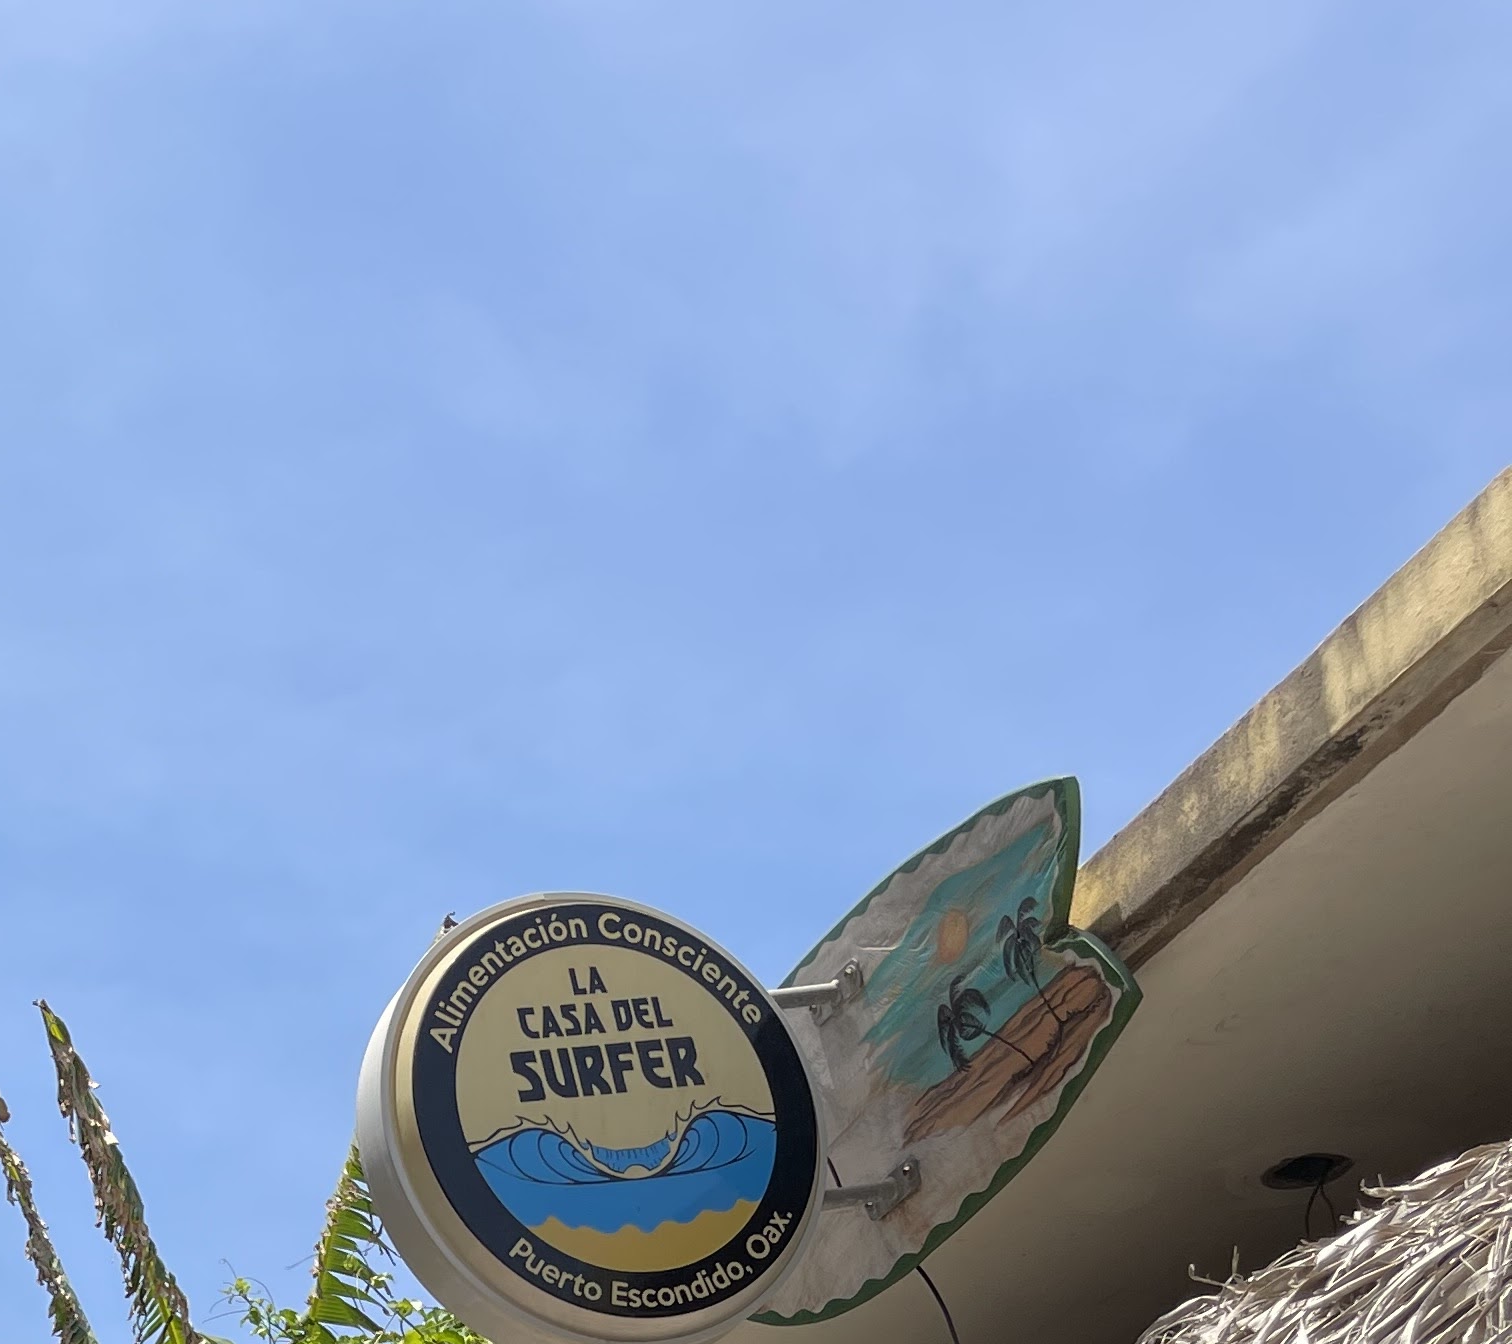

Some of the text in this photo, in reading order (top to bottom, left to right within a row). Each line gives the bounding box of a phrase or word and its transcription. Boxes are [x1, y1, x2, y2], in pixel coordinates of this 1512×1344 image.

[429, 912, 761, 1053] Alimentación Consciente
[568, 966, 608, 995] LA
[516, 996, 673, 1038] CASA DEL
[510, 1036, 705, 1102] SURFER
[509, 1210, 793, 1308] Puerto Escondido, Oax.
